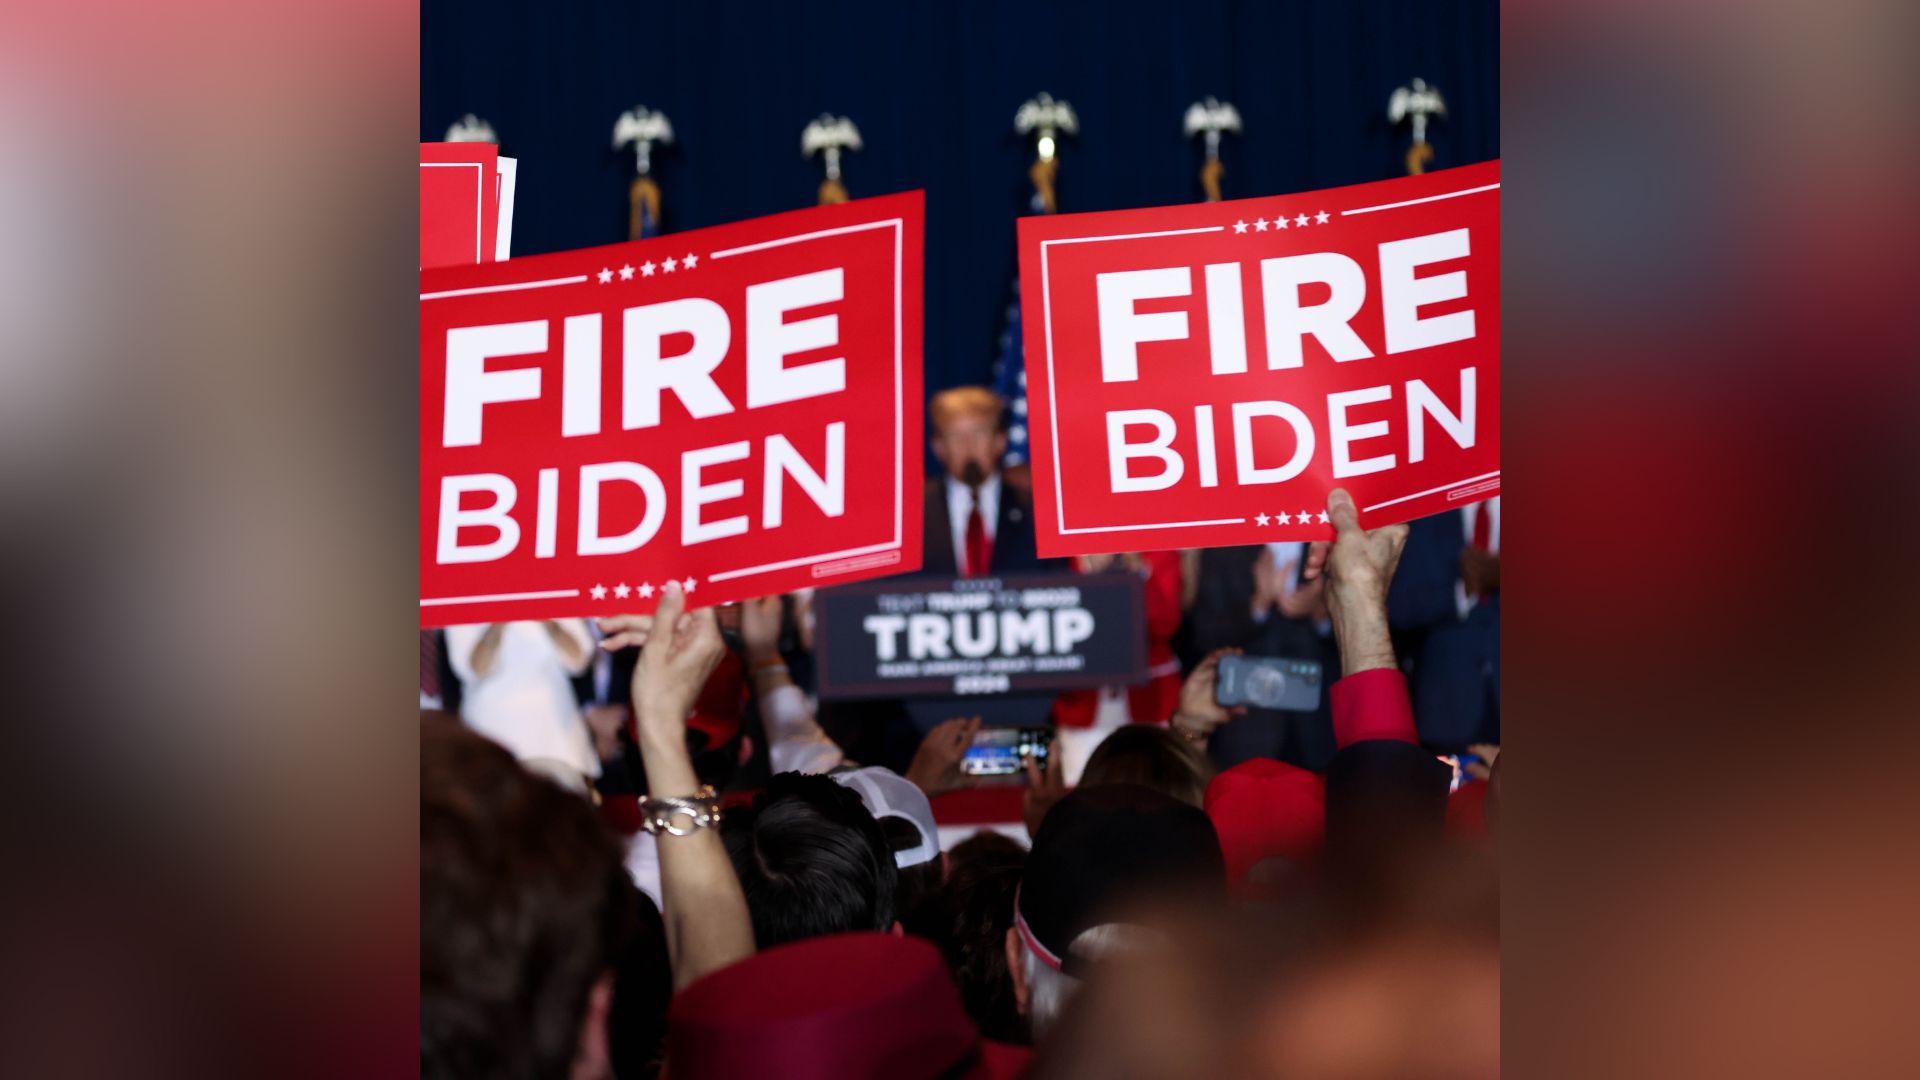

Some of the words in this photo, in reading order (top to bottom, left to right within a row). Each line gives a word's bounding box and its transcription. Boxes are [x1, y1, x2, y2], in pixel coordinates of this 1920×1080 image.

[443, 268, 845, 448] FIRE
[1096, 228, 1476, 383] FIRE
[436, 422, 845, 564] BIDEN
[1106, 367, 1477, 493] BIDEN
[863, 608, 1096, 660] TRUMP
